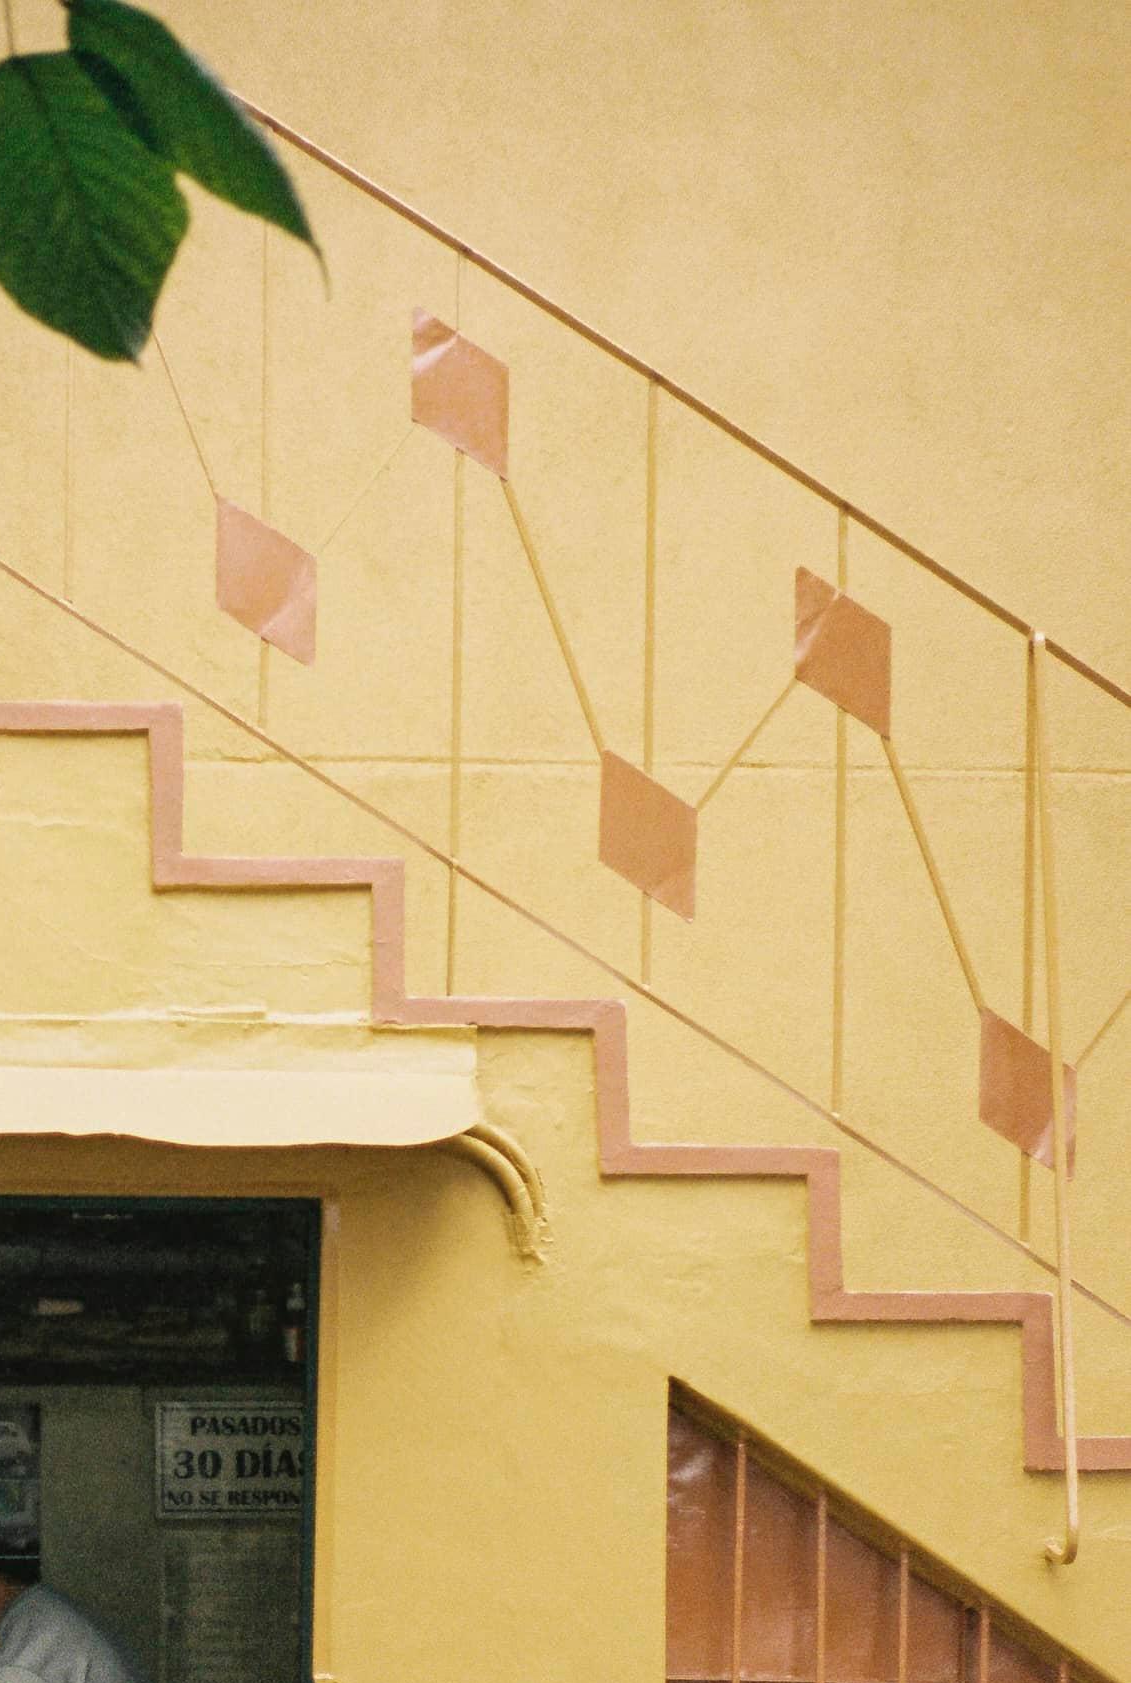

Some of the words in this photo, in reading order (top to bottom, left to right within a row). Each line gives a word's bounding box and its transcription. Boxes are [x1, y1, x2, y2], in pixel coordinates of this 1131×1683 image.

[190, 1416, 301, 1436] PASADOS
[173, 1450, 221, 1479] 30
[162, 1490, 193, 1505] NO
[198, 1490, 220, 1505] SE
